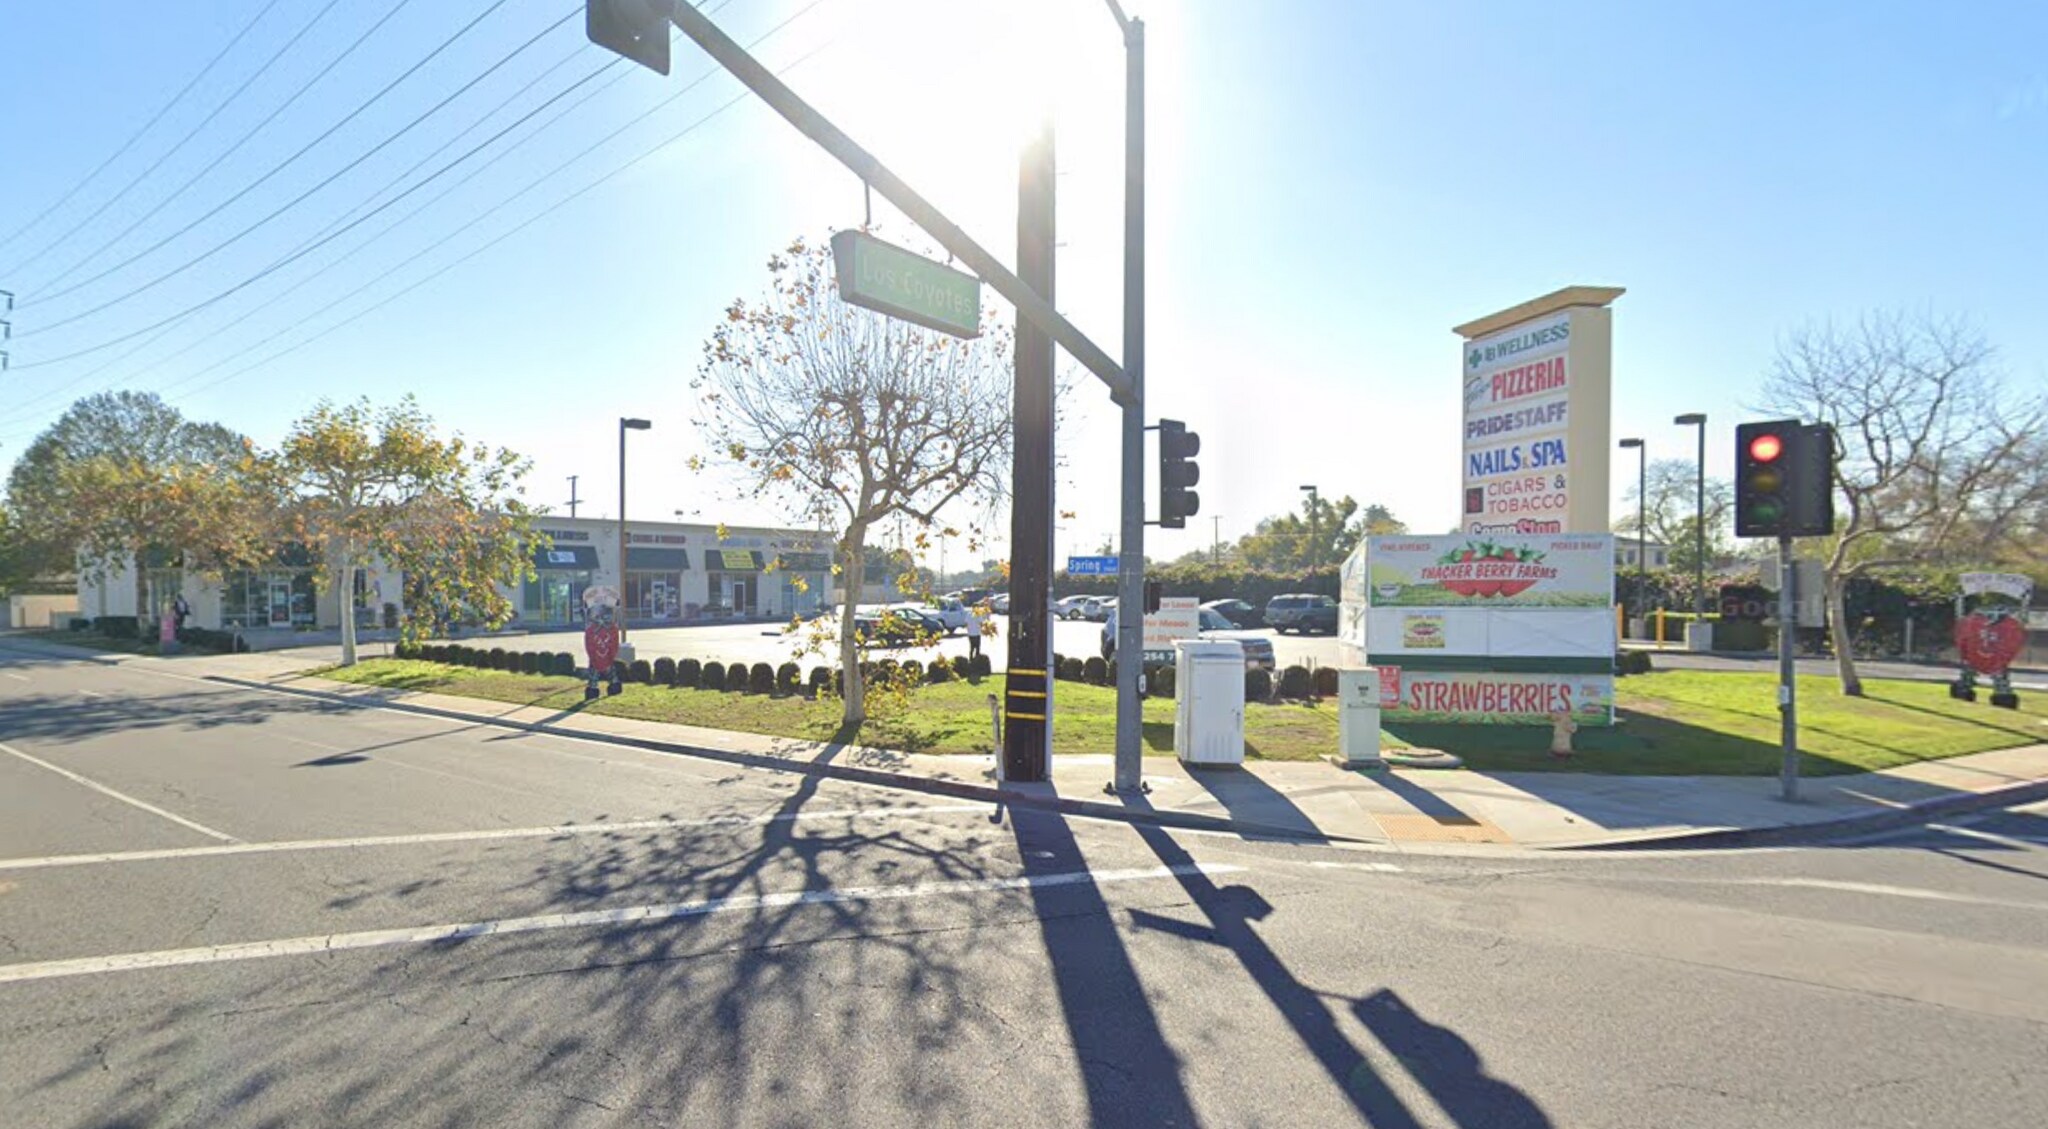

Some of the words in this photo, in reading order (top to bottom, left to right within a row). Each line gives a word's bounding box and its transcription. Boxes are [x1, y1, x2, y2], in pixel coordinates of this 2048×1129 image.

[863, 255, 896, 290] Los
[903, 271, 973, 315] Coyotes
[1497, 322, 1570, 357] WELLNESS
[1492, 357, 1565, 401] PIZZERIA
[1467, 402, 1567, 438] PRIDESTAFF
[1470, 446, 1521, 476] NAILS
[1531, 438, 1566, 468] SPA
[1488, 477, 1546, 496] CIGARS
[1554, 474, 1566, 488] &
[1488, 493, 1567, 514] TOBACCO
[1069, 559, 1101, 572] Spring
[1421, 563, 1473, 579] THACKER
[1476, 563, 1516, 578] BERRY
[1517, 564, 1559, 579] FARMS
[1410, 681, 1572, 713] STRAWBERRIES
